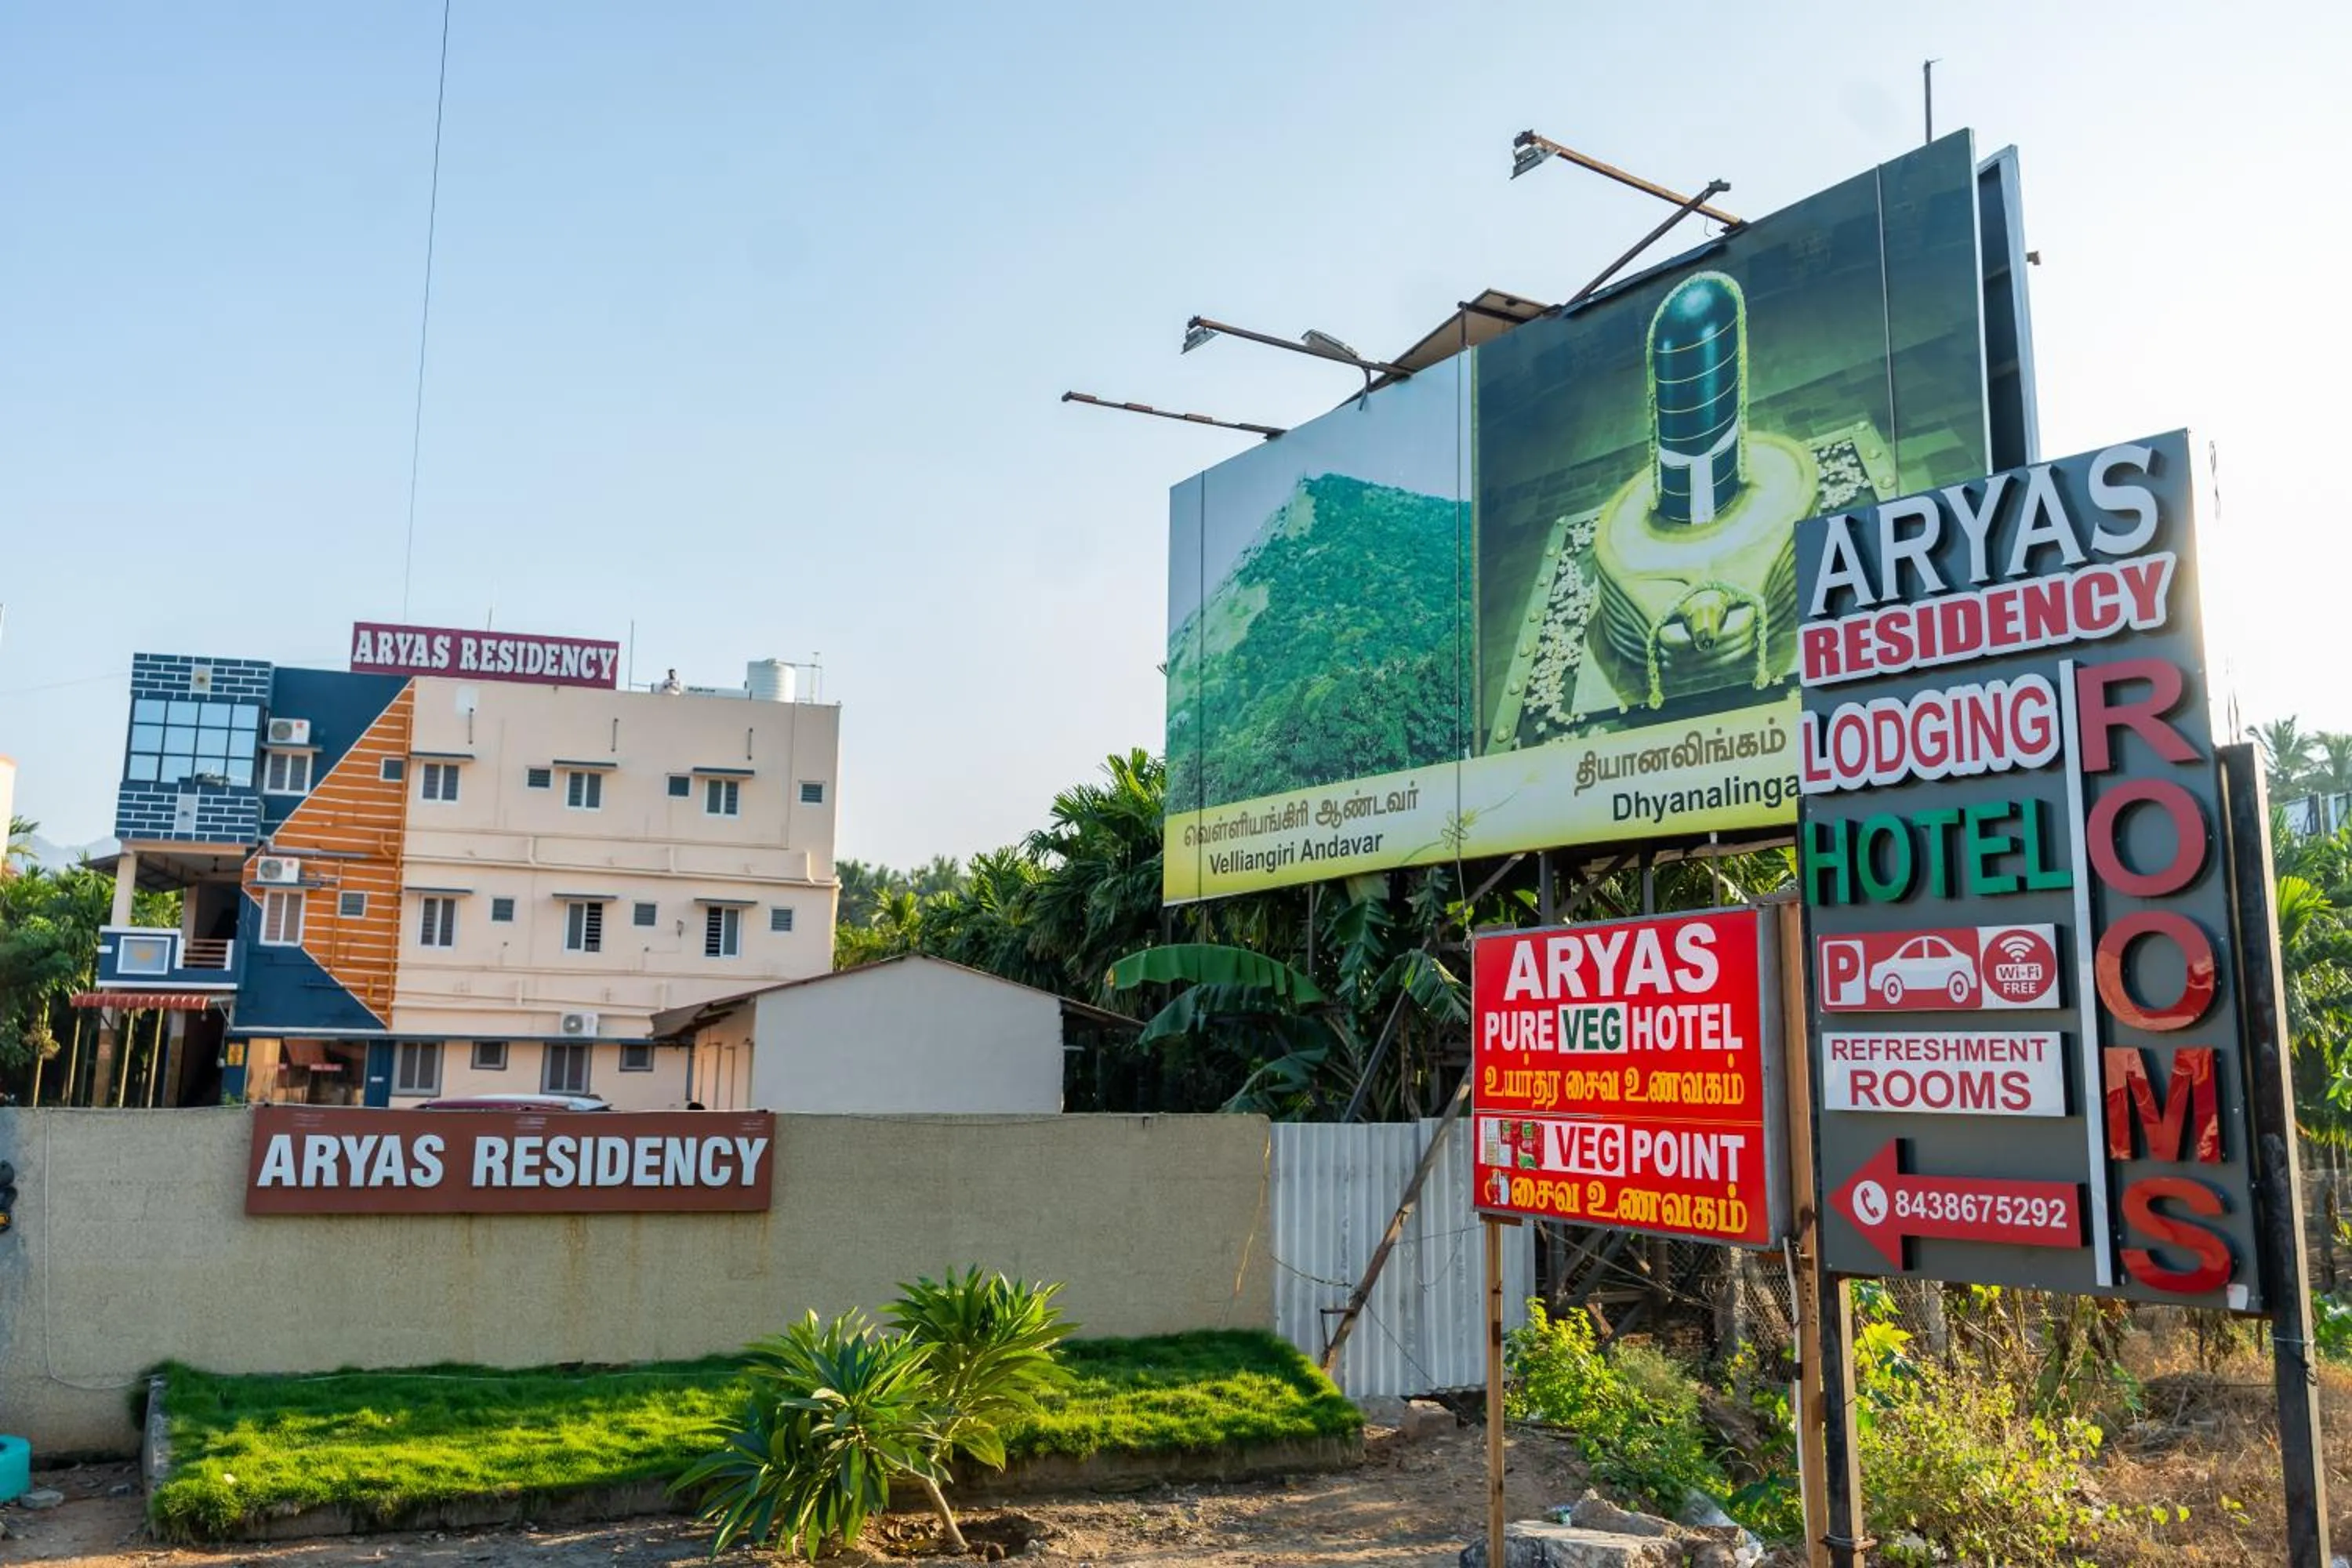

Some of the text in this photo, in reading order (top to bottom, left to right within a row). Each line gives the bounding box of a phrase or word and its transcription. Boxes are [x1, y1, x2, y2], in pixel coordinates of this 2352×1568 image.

[1808, 443, 2159, 619] ARYAS
[1802, 560, 2169, 680] RESIDENCY
[352, 630, 618, 681] ARYAS RESIDENCY
[1574, 717, 1788, 797] தியானலிங்கம்
[1803, 685, 2052, 782] LODGING
[1184, 780, 1420, 847] வெள்ளியங்கிரி ஆண்டவர்
[1613, 774, 1802, 824] Dhyanalinga
[1209, 833, 1384, 875] Velliangiri Andavar
[1805, 798, 2072, 906] HOTEL
[1503, 923, 1720, 1002] ARYAS
[1828, 944, 1860, 1002] P
[1998, 965, 2040, 979] Wi-Fi
[2002, 982, 2037, 995] FREE
[2075, 657, 2234, 1294] ROOMS
[1484, 1003, 1744, 1051] PURE VEG HOTEL
[1831, 1038, 2049, 1062] REFRESHMENT
[1484, 1053, 1745, 1112] உயர்தர சைவ உணவகம்
[1849, 1069, 2032, 1111] ROOMS
[256, 1134, 768, 1189] ARYAS RESIDENCY
[1555, 1124, 1746, 1183] VEG POINT
[1511, 1177, 1748, 1234] சைவ உணவகம்
[1894, 1189, 2068, 1229] 8438675292
